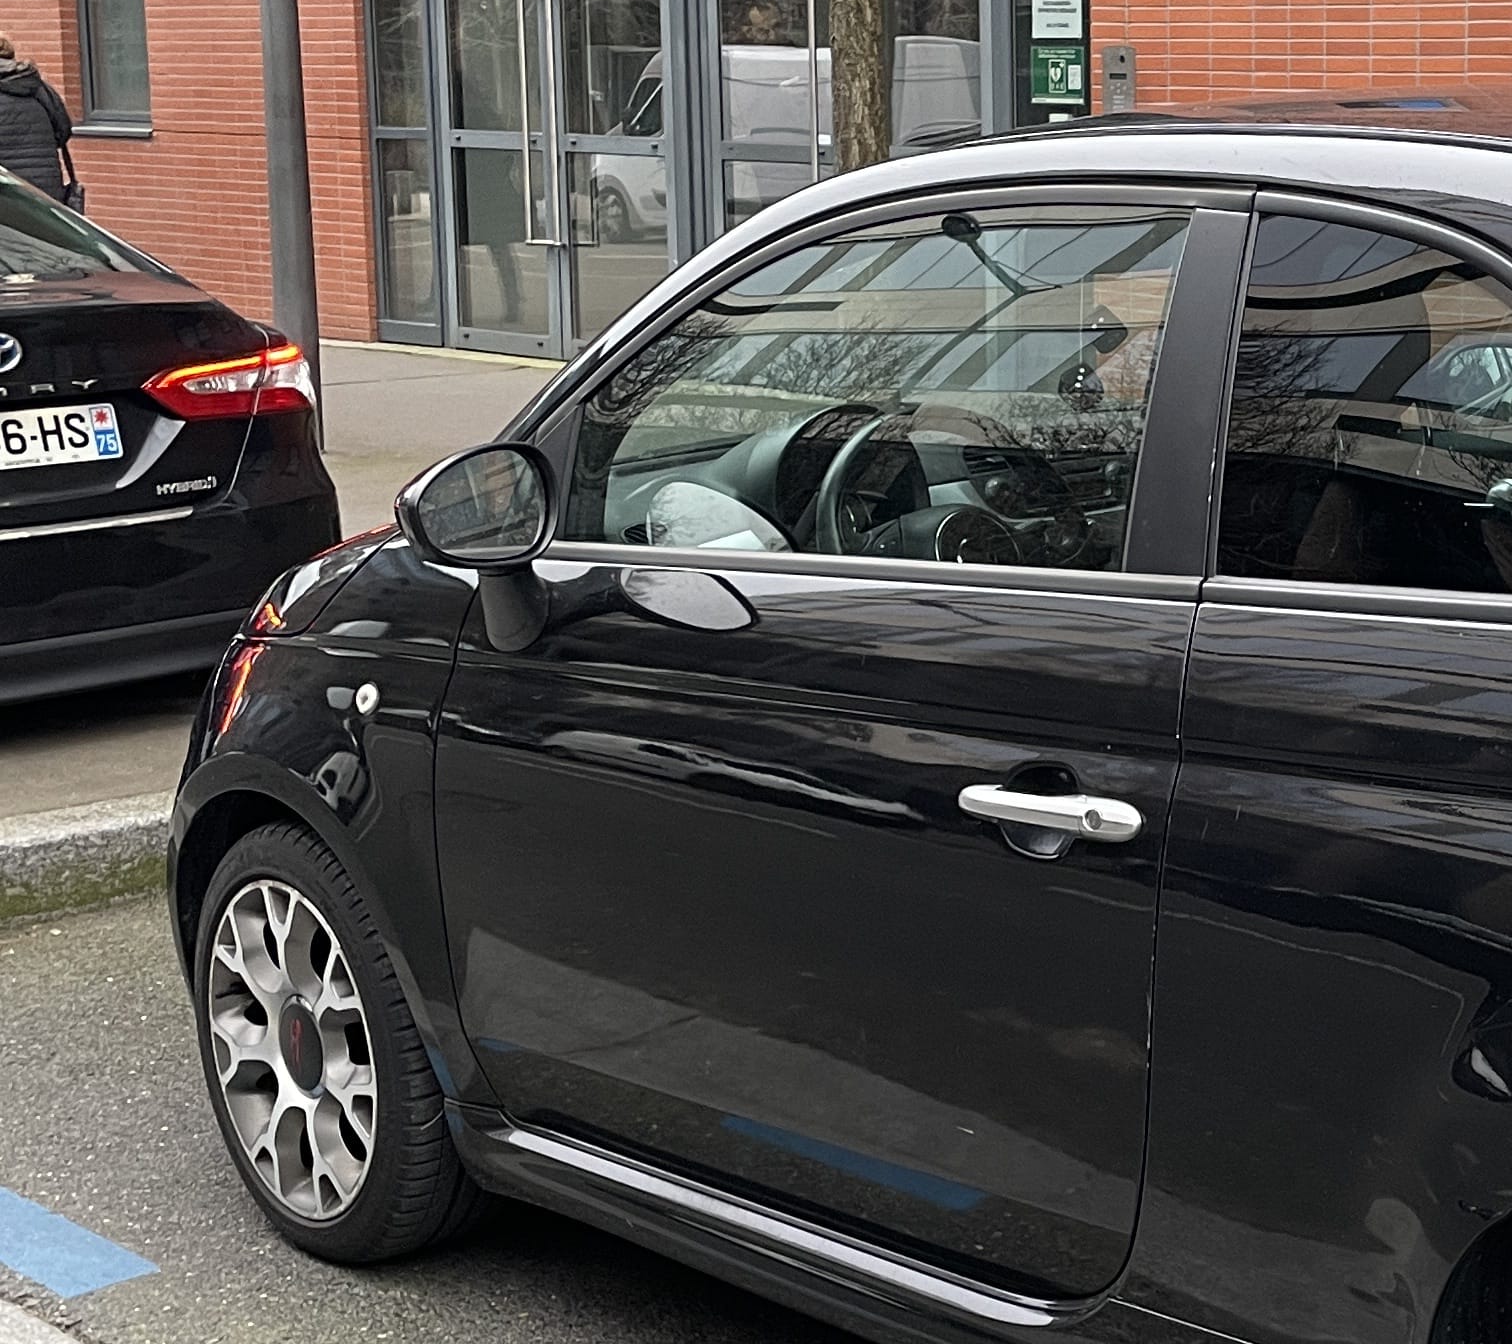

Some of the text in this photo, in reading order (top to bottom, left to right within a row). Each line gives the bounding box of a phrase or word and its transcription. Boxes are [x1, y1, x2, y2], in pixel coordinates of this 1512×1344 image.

[0, 379, 98, 396] RY
[97, 433, 118, 453] 75
[156, 478, 208, 496] HYBRID
